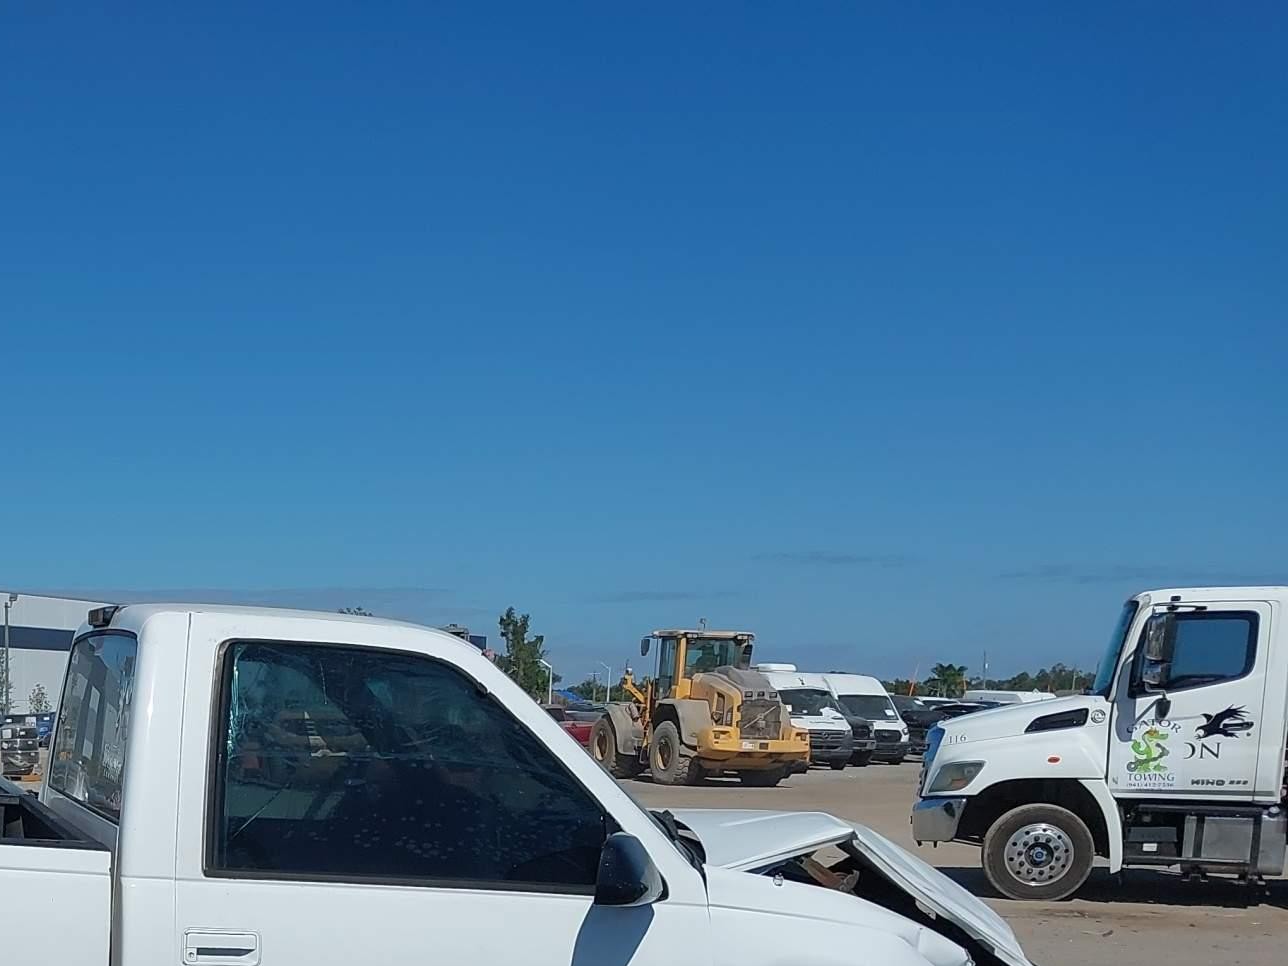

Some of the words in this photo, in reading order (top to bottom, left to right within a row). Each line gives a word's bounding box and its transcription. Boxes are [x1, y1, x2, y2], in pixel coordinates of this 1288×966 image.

[1126, 718, 1182, 735] GATOR
[948, 735, 967, 744] 116
[1127, 772, 1175, 782] TOWING
